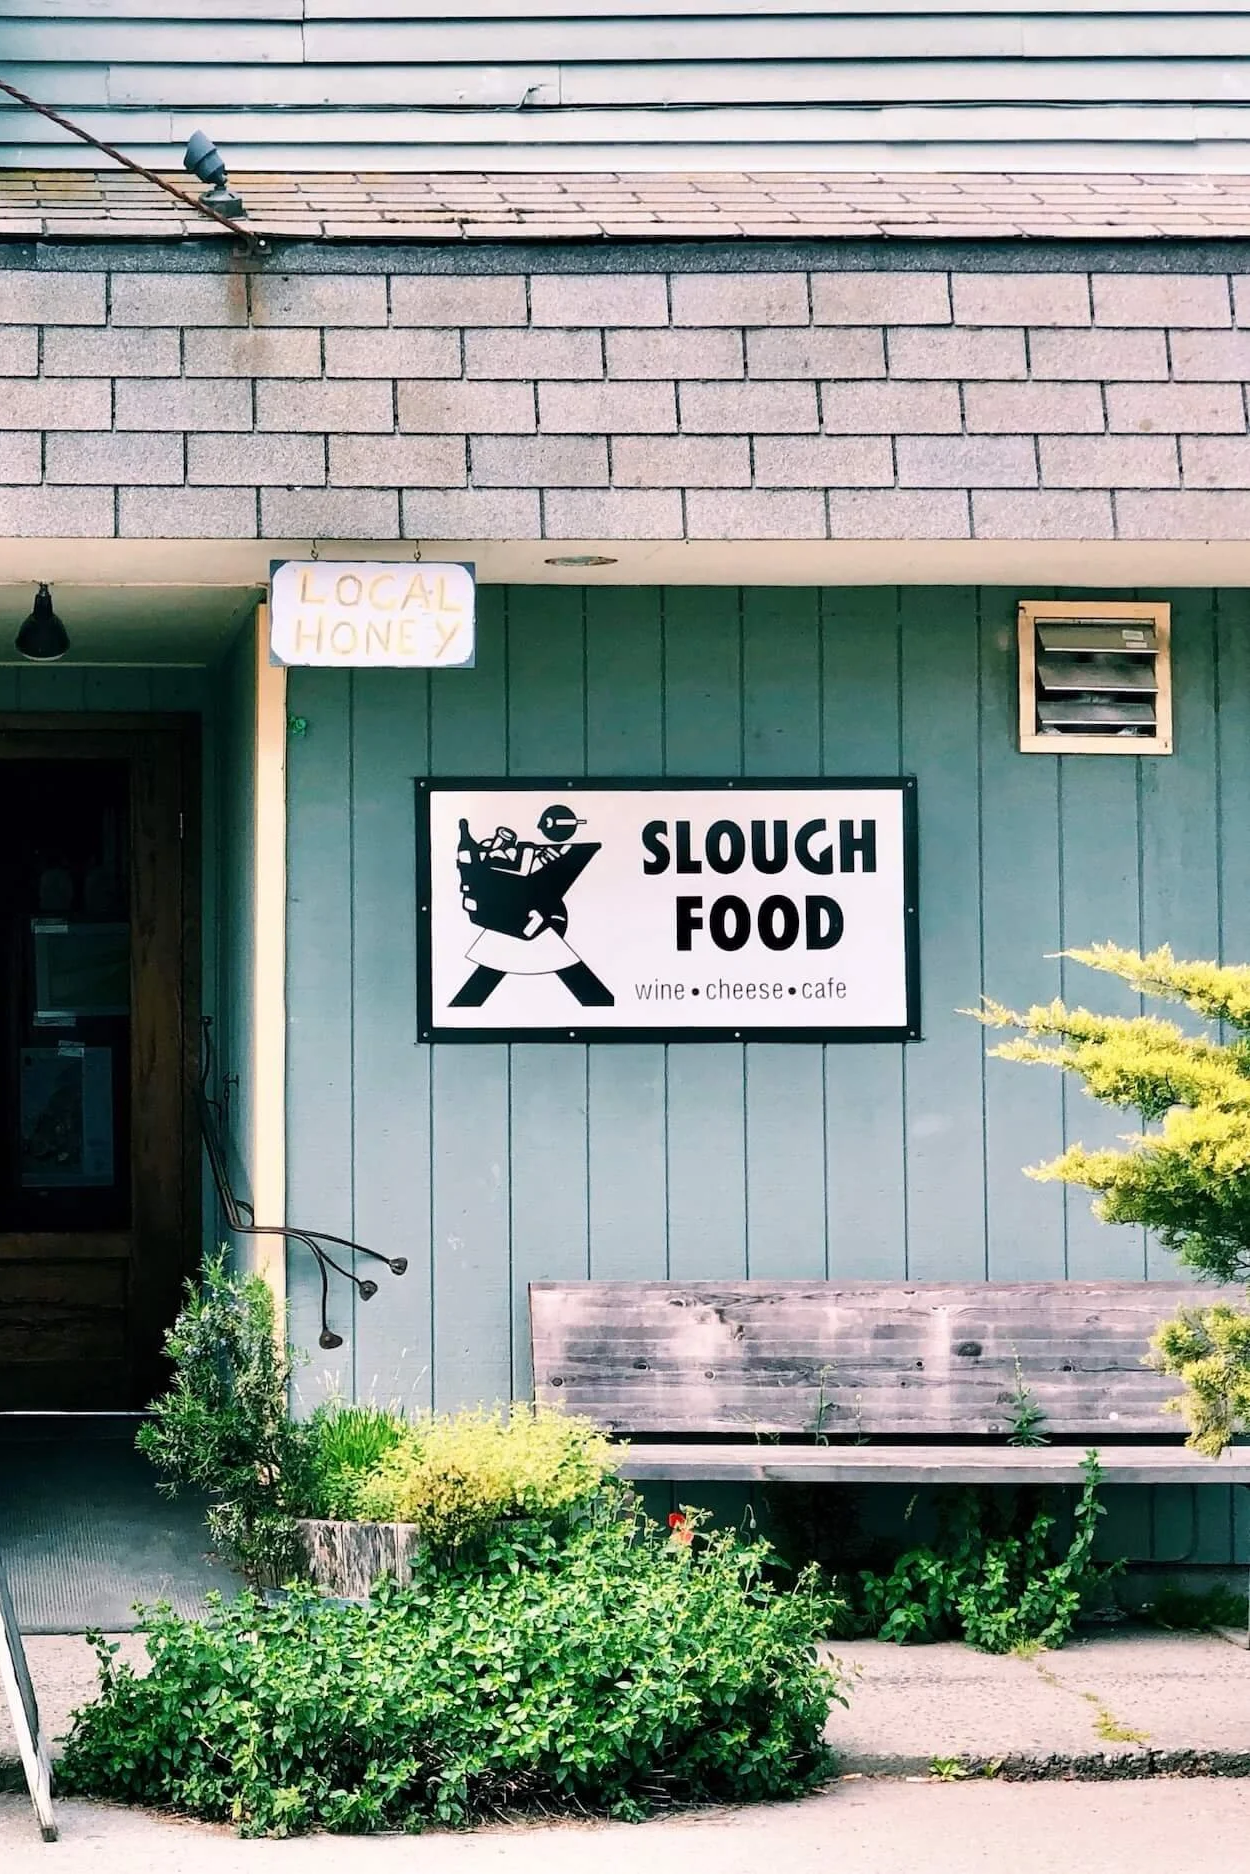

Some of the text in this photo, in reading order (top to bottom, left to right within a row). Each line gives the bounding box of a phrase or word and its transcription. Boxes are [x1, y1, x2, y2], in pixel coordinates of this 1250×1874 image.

[299, 570, 463, 612] LOCAL
[295, 616, 462, 660] HONEY
[642, 819, 877, 875] SLOUGH
[676, 895, 843, 951] FOOD
[635, 977, 847, 1000] wine cheese cafe
